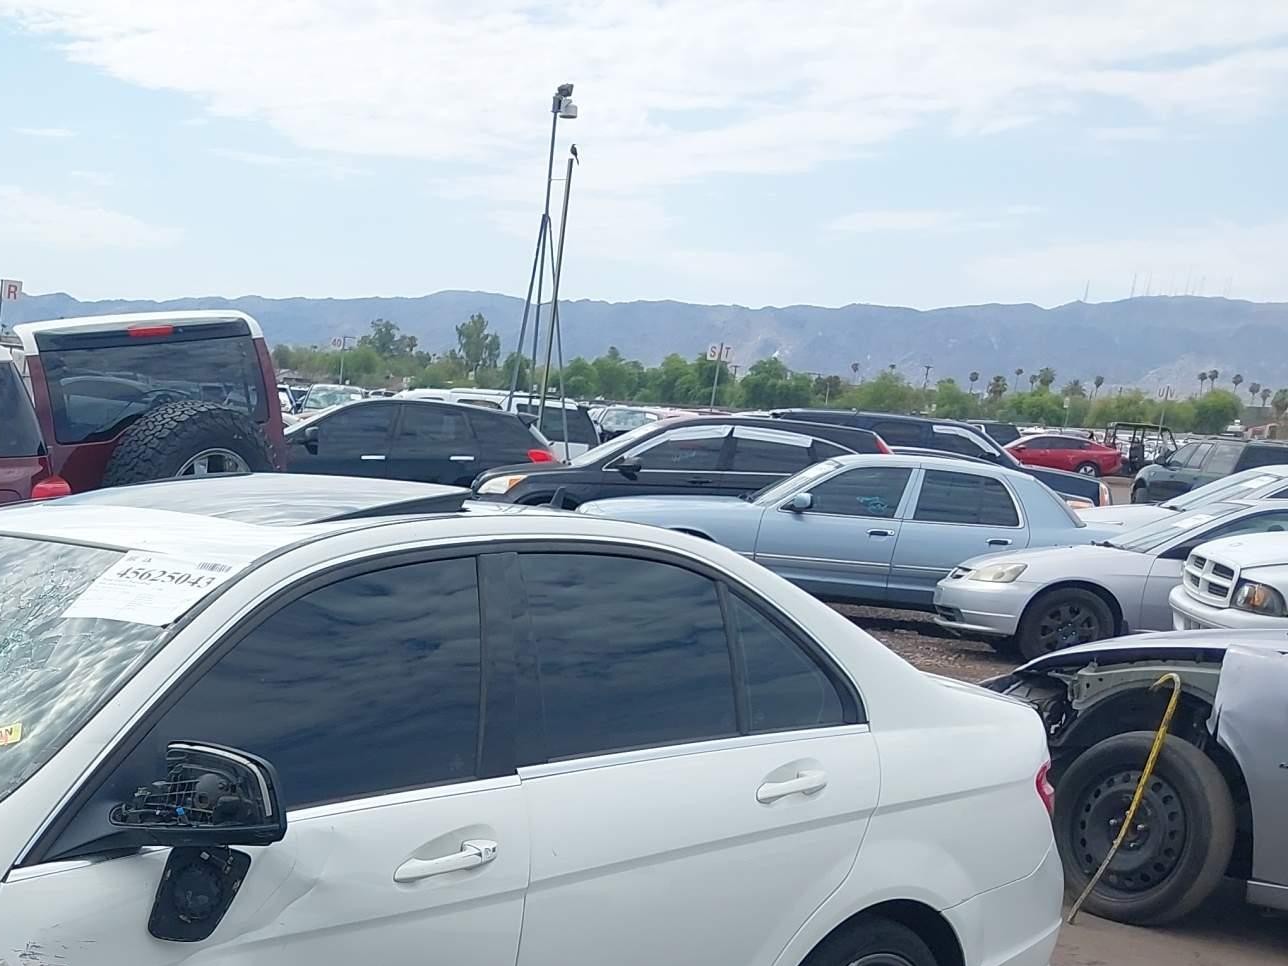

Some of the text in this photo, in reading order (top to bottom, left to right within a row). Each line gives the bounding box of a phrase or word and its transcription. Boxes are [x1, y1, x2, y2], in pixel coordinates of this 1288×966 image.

[7, 284, 18, 300] R
[710, 345, 717, 358] S
[725, 346, 732, 359] T
[116, 566, 216, 589] 45625043
